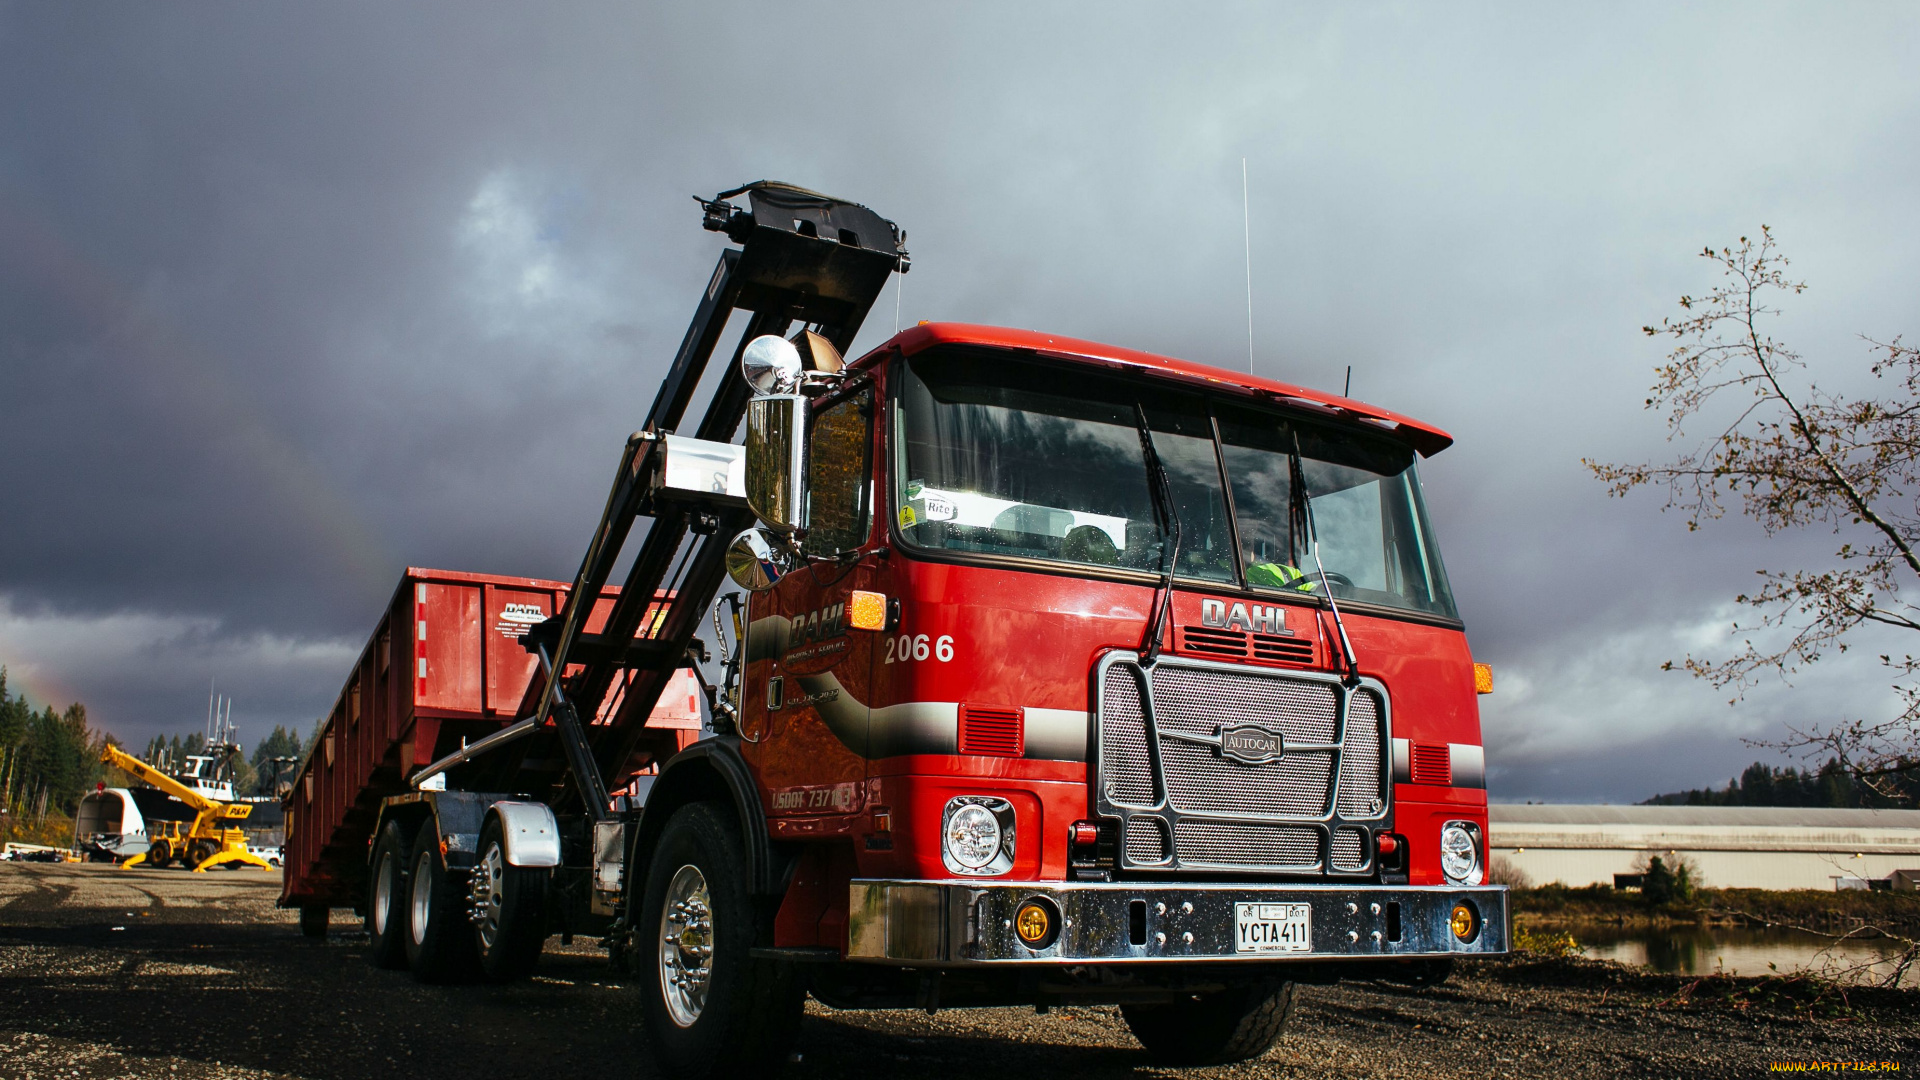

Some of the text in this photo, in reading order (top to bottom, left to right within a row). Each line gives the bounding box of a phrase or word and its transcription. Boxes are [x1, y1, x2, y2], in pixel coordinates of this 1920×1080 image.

[505, 603, 543, 616] DAHL
[1202, 598, 1294, 637] DAHL
[789, 602, 847, 648] DAHL
[885, 634, 954, 664] 2066
[1227, 736, 1277, 750] AUTOCAR
[771, 791, 805, 809] USDOT
[229, 807, 249, 816] P&H
[1240, 922, 1306, 943] YCTA411
